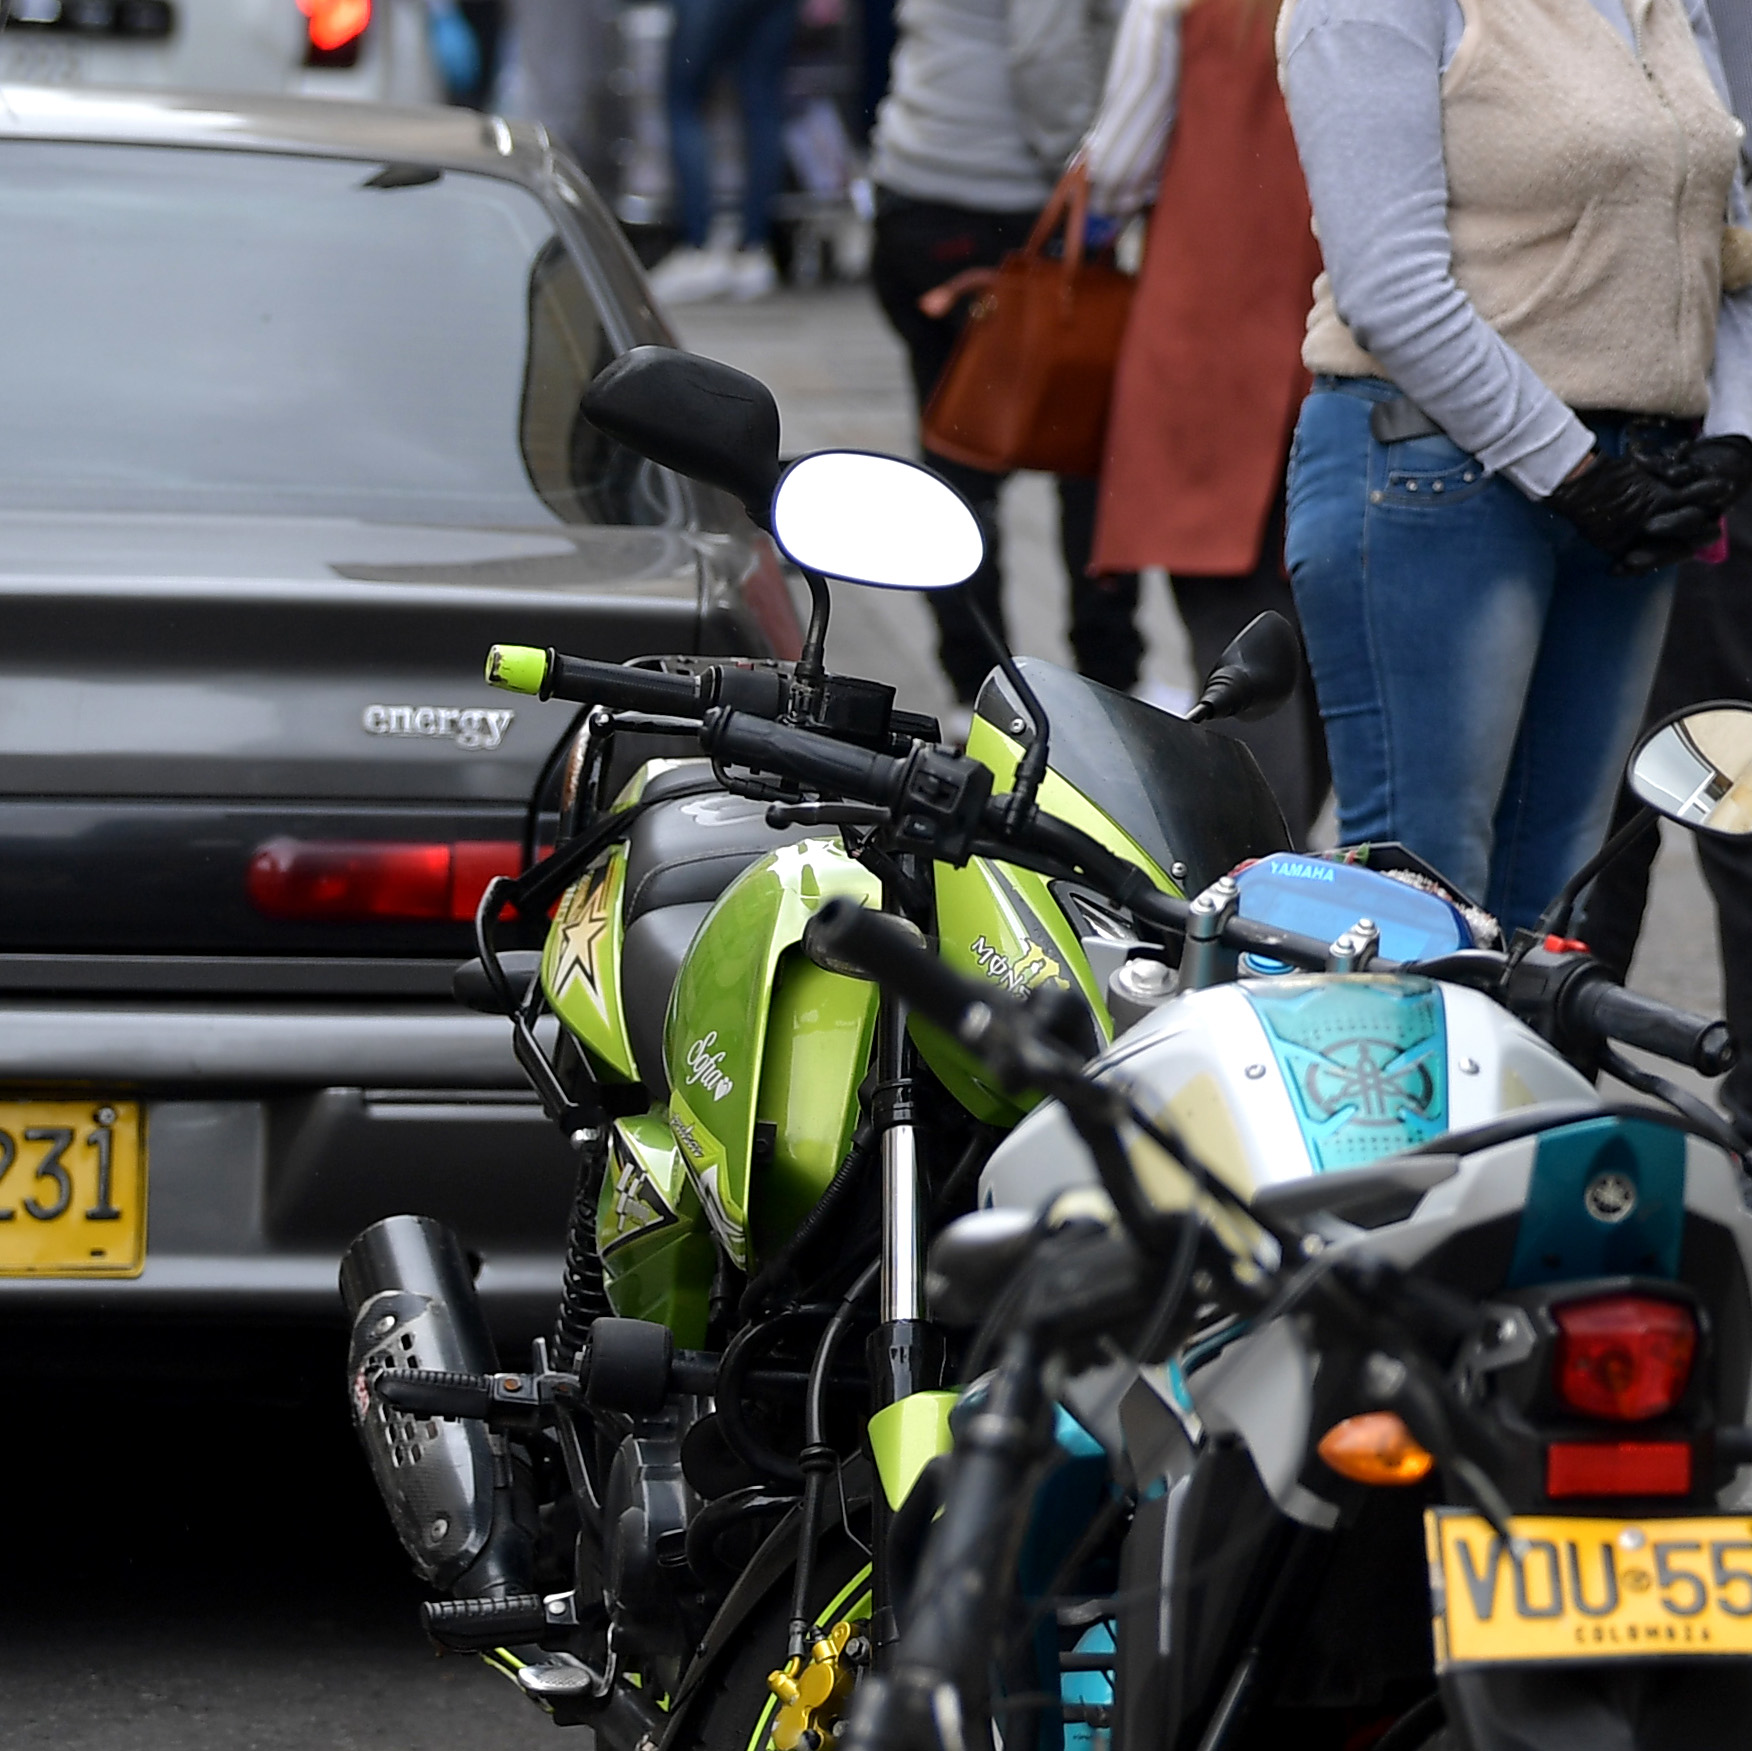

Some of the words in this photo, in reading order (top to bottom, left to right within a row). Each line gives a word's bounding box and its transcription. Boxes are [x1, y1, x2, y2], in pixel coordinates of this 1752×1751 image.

[363, 704, 515, 751] energy
[1270, 861, 1335, 882] YAMAHA
[686, 1031, 723, 1091] Sofia
[1576, 1626, 1712, 1645] COLOMBIA
